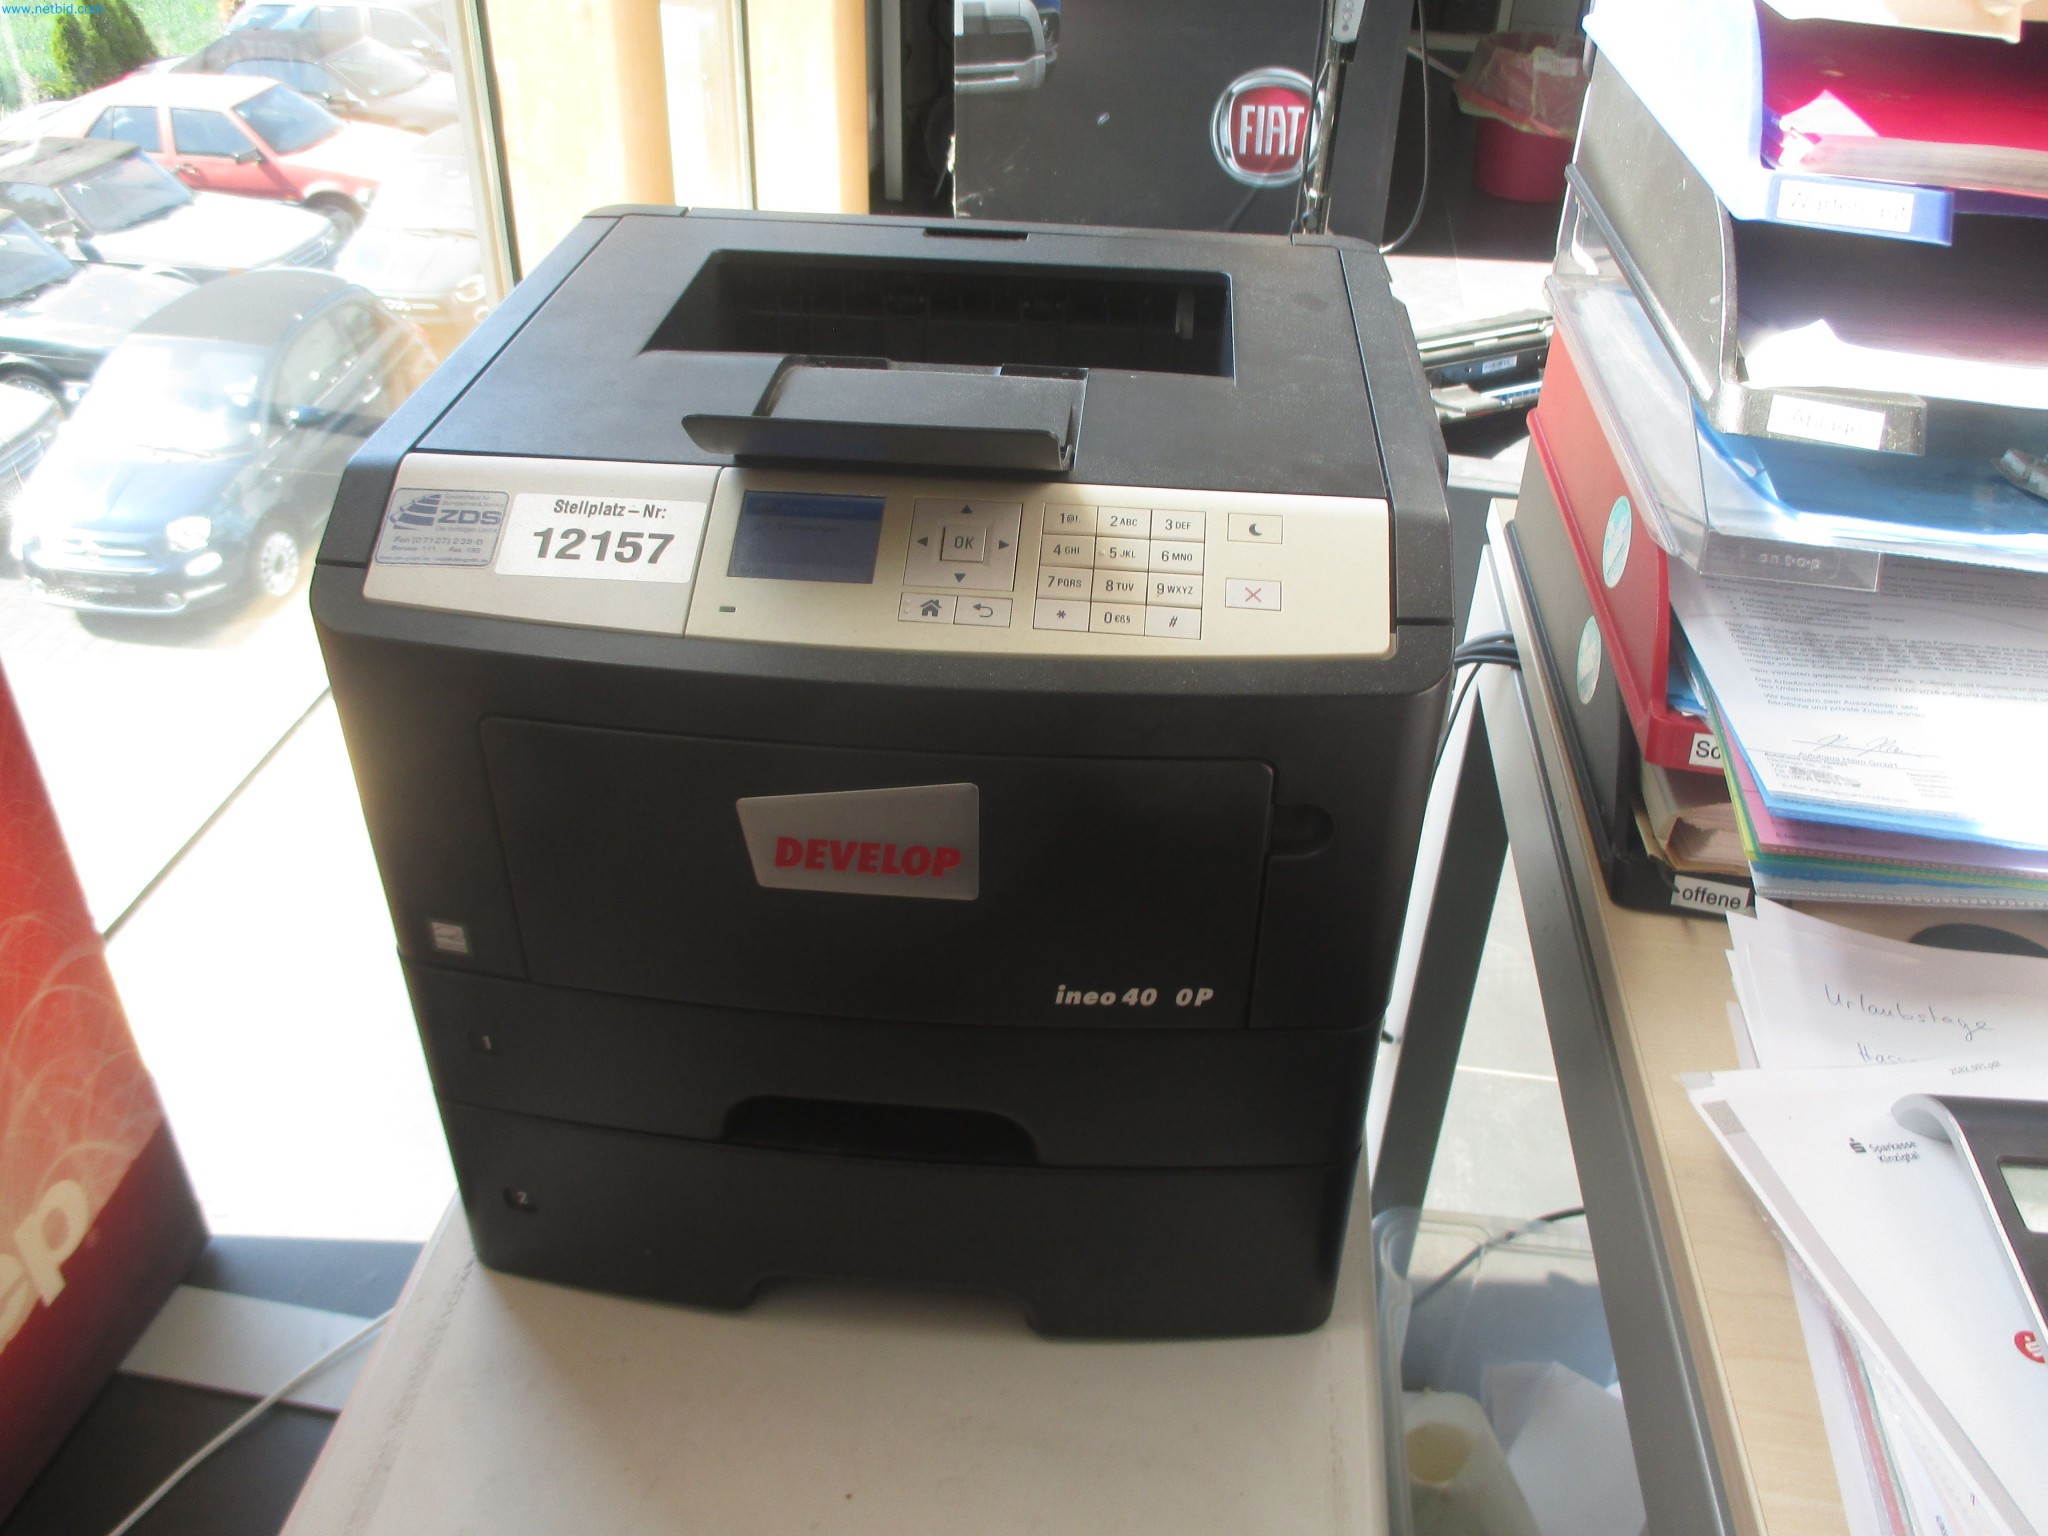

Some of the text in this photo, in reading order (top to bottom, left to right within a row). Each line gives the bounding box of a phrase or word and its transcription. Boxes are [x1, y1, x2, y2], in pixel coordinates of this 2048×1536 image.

[1239, 105, 1305, 156] FIAT
[437, 509, 503, 525] ZDS
[533, 527, 676, 565] 12157
[954, 535, 975, 550] OK
[774, 836, 963, 879] DEVELOP
[1682, 887, 1741, 910] offene
[1054, 984, 1117, 1006] ineo
[1121, 987, 1158, 1006] 40
[1869, 1140, 1918, 1153] Sparkasse
